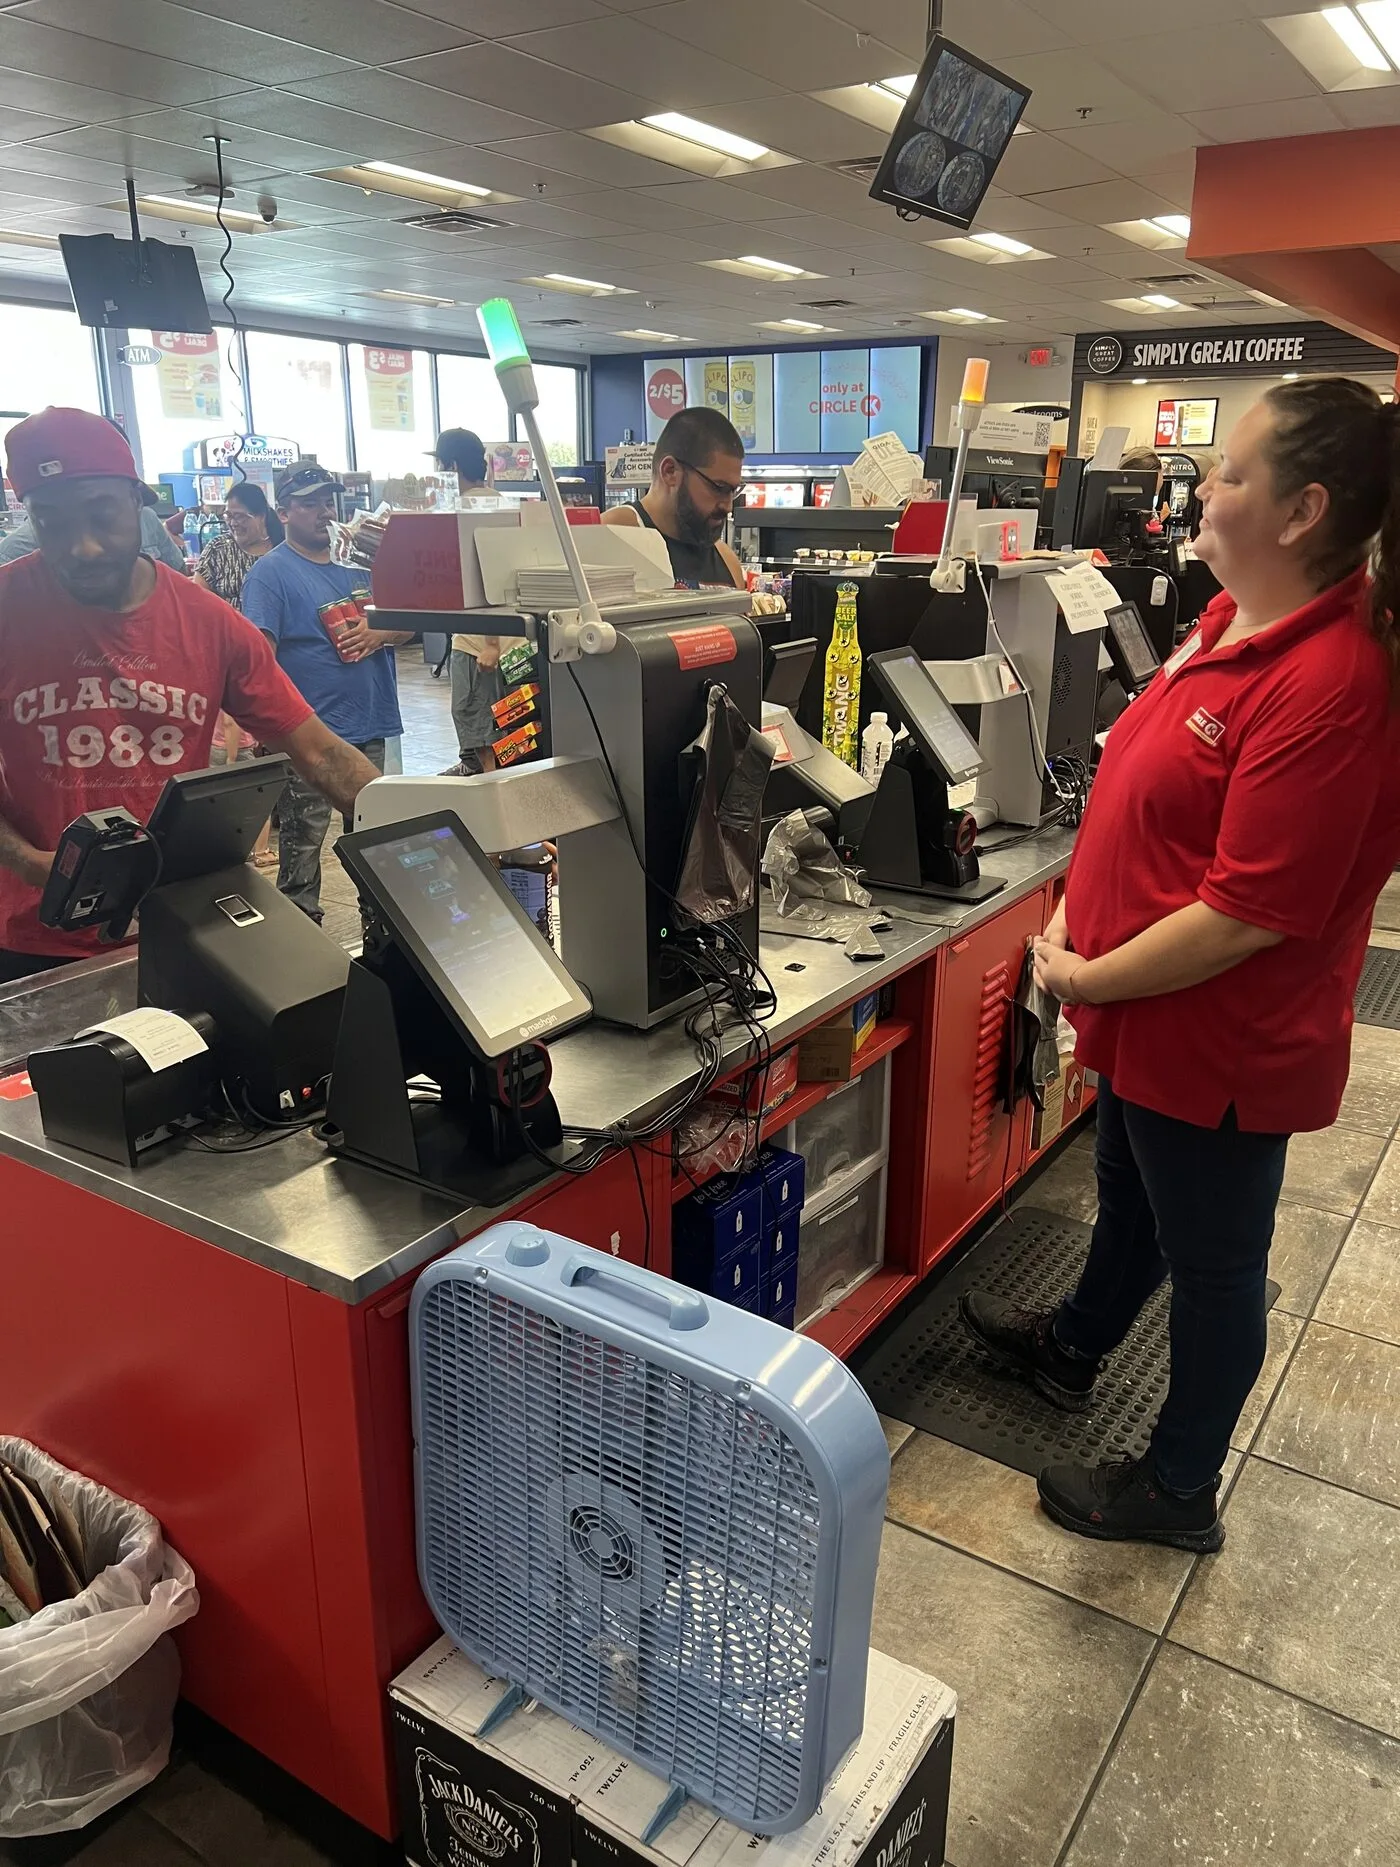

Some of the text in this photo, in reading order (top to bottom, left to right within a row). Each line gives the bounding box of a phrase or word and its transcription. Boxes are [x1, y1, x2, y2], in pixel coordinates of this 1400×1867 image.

[128, 348, 151, 362] ATM
[1133, 336, 1305, 367] SIMPLY GREAT COFFEE
[649, 384, 684, 405] 2/$5
[822, 382, 864, 395] only at
[809, 399, 857, 414] CIRCLE
[243, 448, 294, 457] MILKSHAKES
[986, 455, 1014, 466] ViewSonic
[1170, 463, 1194, 471] NITRO
[835, 607, 857, 615] BEER
[836, 613, 857, 621] SALT
[13, 676, 208, 726] CLASSIC
[37, 724, 185, 768] 1988
[527, 1013, 558, 1035] mashgin
[423, 1657, 448, 1679] GLASS
[395, 1710, 426, 1736] TWELVE
[888, 1694, 928, 1753] FRAGILE GLASS
[578, 1754, 595, 1772] 750
[596, 1760, 629, 1797] TWELVE
[850, 1758, 886, 1811] THIS END UP
[529, 1790, 545, 1806] 750
[428, 1774, 523, 1853] JACK DANIEL'S
[584, 1828, 620, 1856] TWELVE
[814, 1818, 850, 1864] THE U.S.A.
